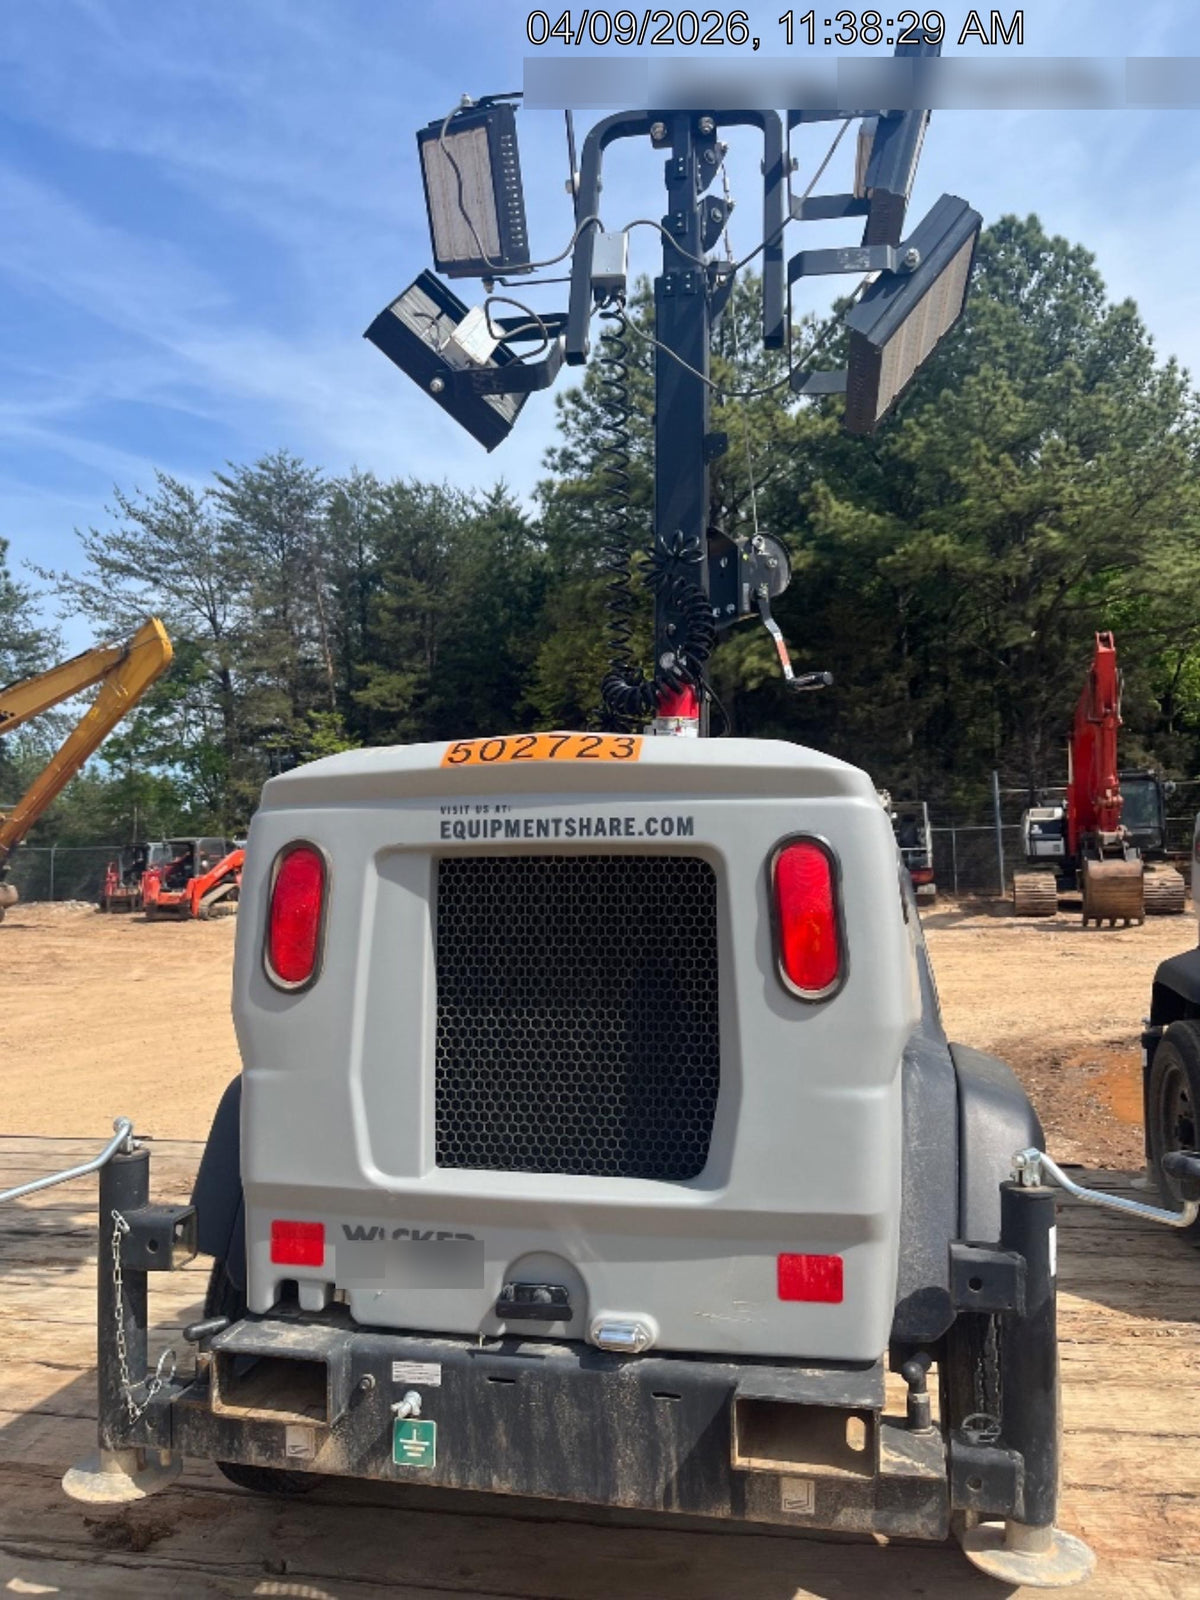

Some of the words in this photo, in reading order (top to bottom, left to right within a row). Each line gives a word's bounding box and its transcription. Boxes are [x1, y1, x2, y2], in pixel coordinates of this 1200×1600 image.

[447, 735, 636, 763] 502723
[440, 805, 469, 815] VISIT
[475, 804, 489, 814] US
[440, 816, 694, 840] EQUIPMENTSHARE.COM
